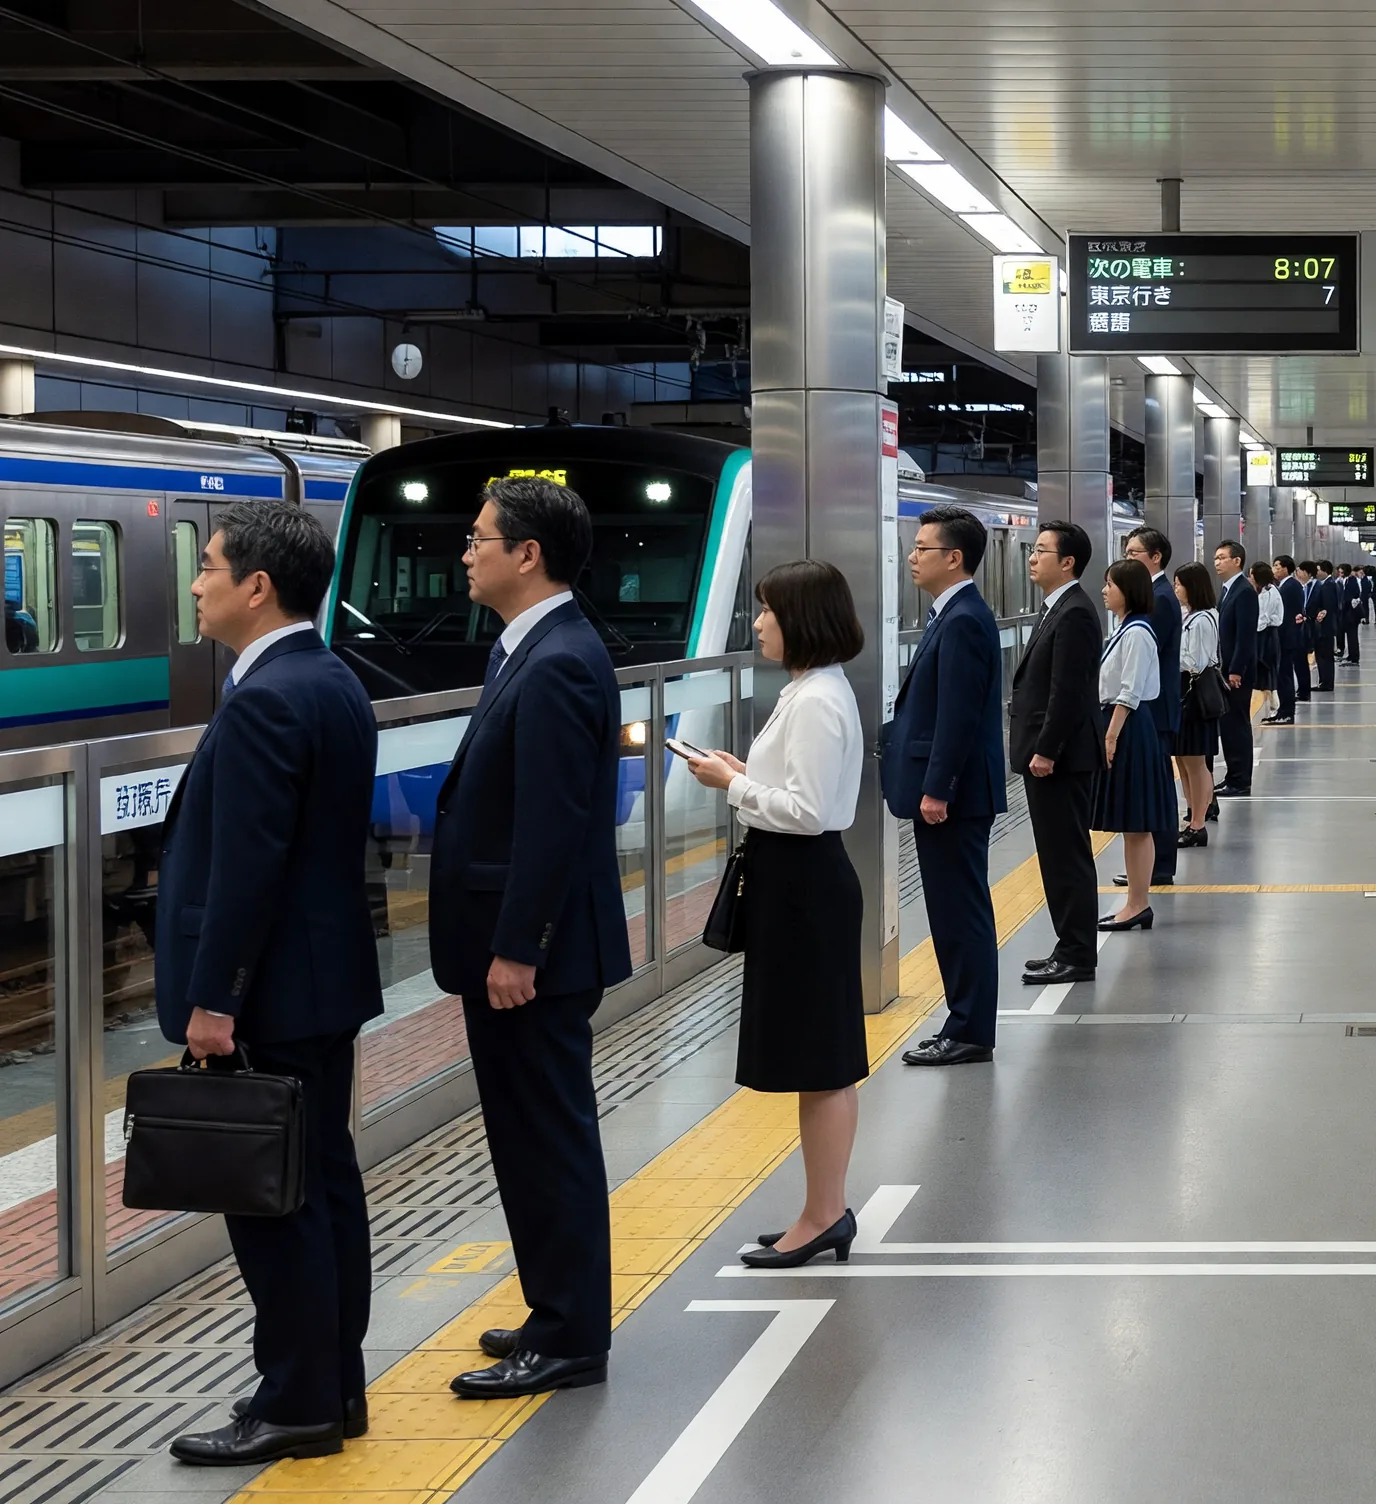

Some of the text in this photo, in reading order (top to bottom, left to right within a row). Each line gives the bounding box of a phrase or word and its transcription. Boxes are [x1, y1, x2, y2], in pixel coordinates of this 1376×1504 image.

[1274, 257, 1336, 280] 8:07
[1089, 284, 1335, 306] 東京行き 7
